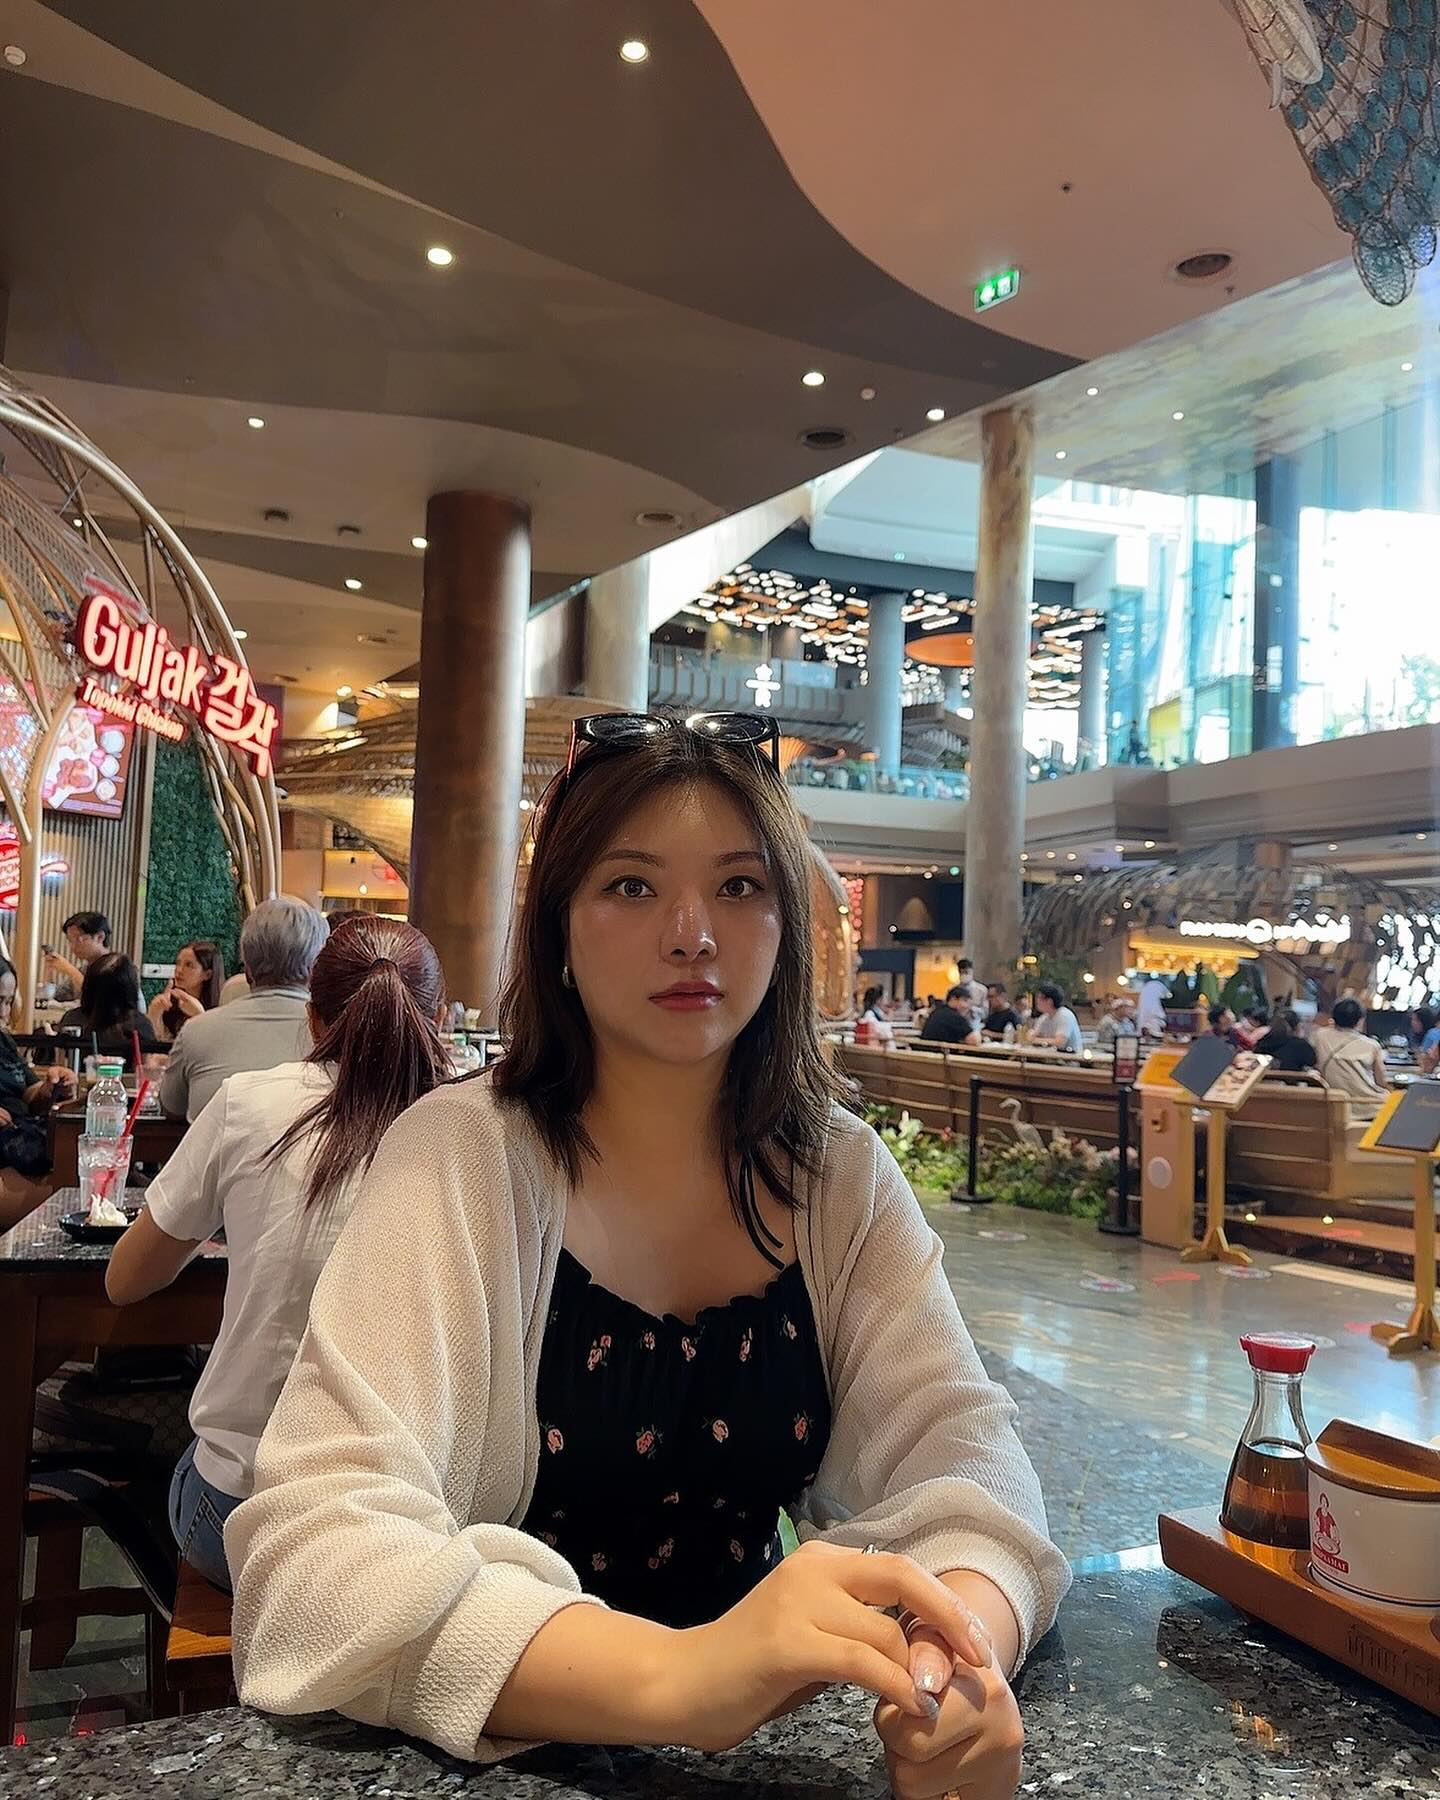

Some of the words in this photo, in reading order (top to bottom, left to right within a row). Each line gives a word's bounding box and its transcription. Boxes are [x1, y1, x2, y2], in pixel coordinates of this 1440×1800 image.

[83, 595, 207, 712] Guljak
[205, 655, 279, 777] 걸작
[136, 703, 184, 741] Chicken
